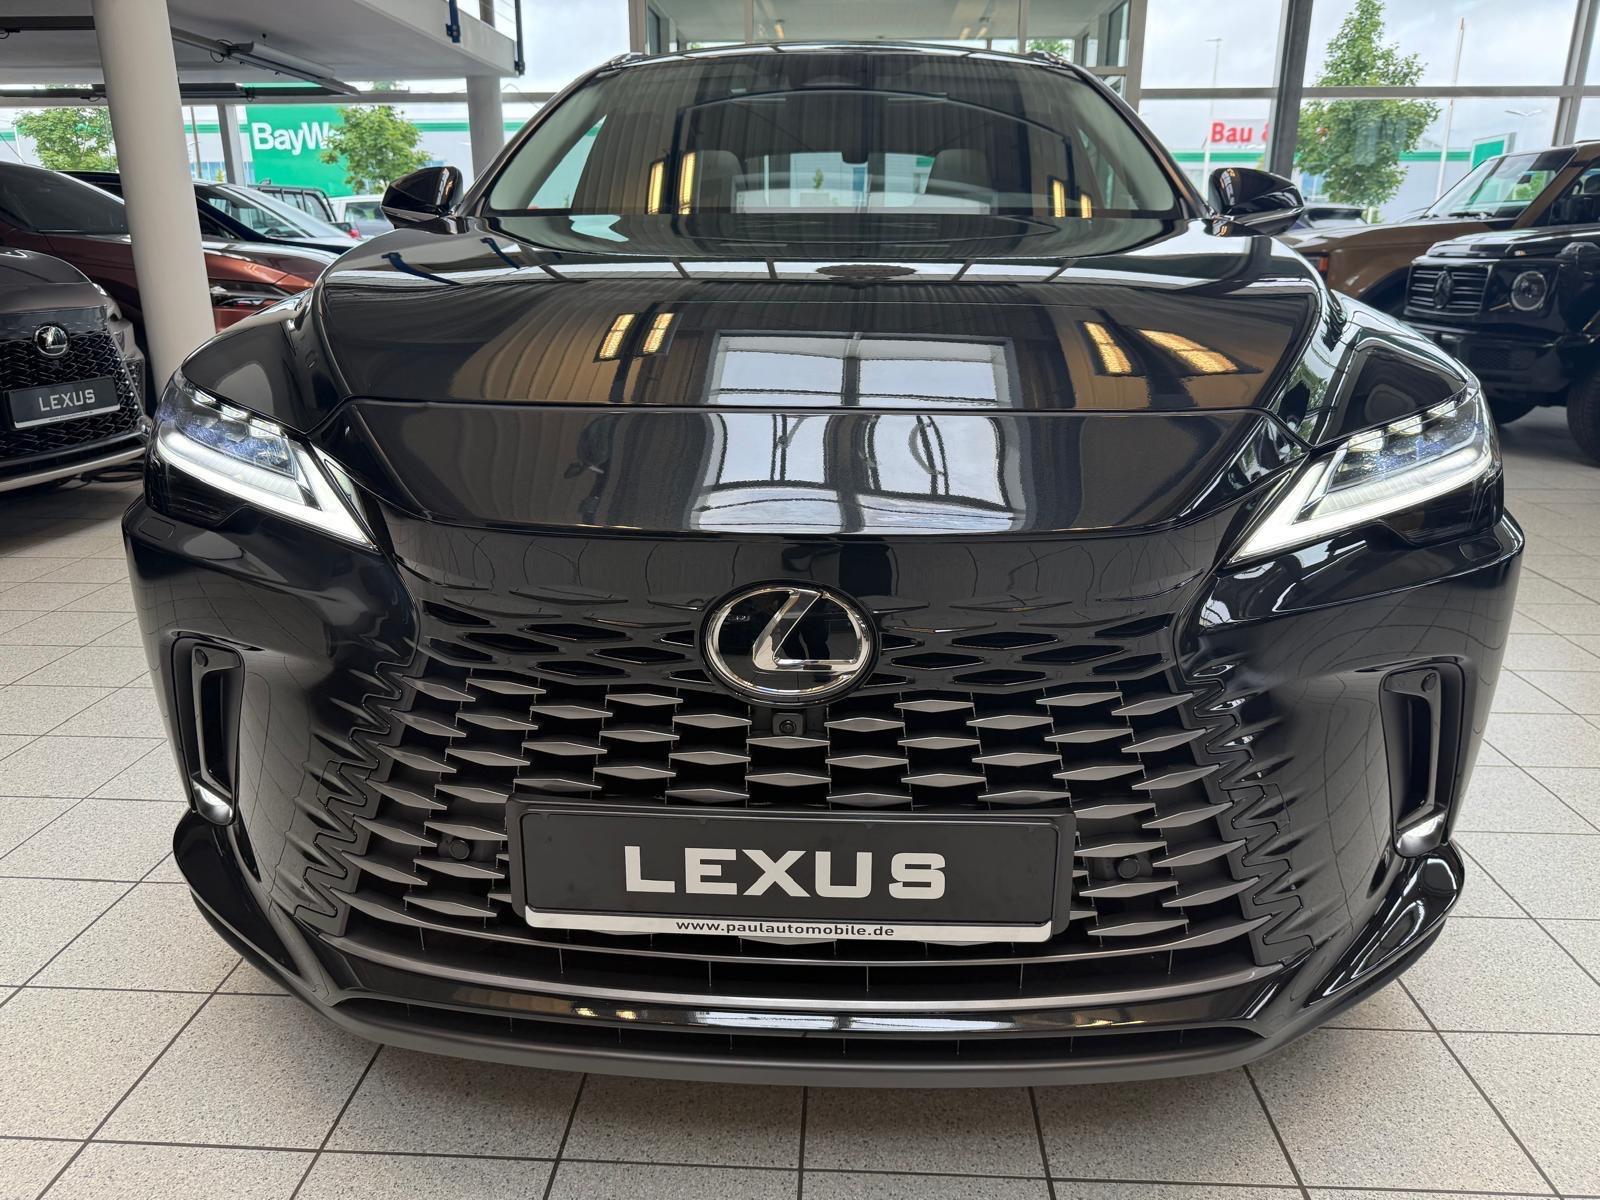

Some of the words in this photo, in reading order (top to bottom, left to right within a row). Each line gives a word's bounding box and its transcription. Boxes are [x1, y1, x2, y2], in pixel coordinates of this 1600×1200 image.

[1211, 122, 1252, 143] Bau
[39, 389, 96, 412] LEXUS
[625, 845, 946, 900] LEXUS
[675, 919, 895, 937] www.paulautomobile.de
